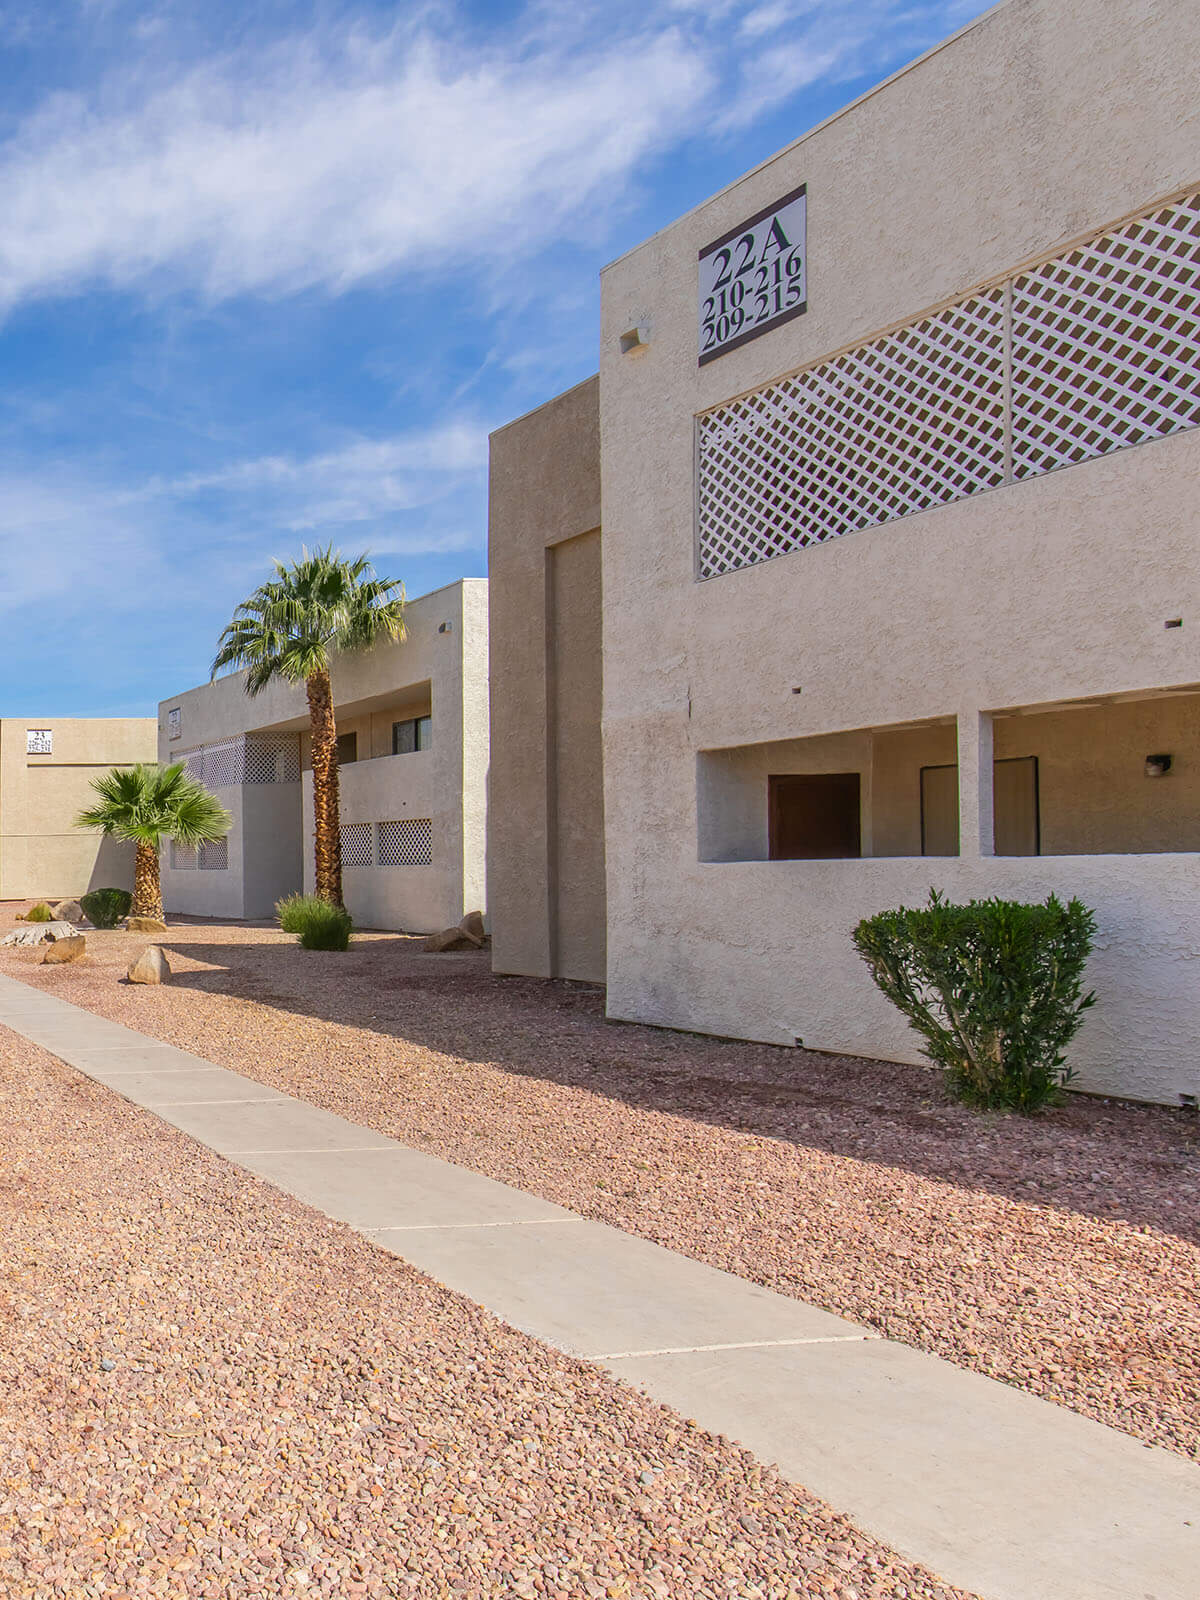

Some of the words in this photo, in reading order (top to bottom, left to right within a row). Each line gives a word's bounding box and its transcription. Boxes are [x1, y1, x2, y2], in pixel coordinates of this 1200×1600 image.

[702, 244, 801, 326] 210-216
[711, 216, 793, 292] 22A
[702, 274, 801, 351] 209-215
[34, 732, 46, 740] 23
